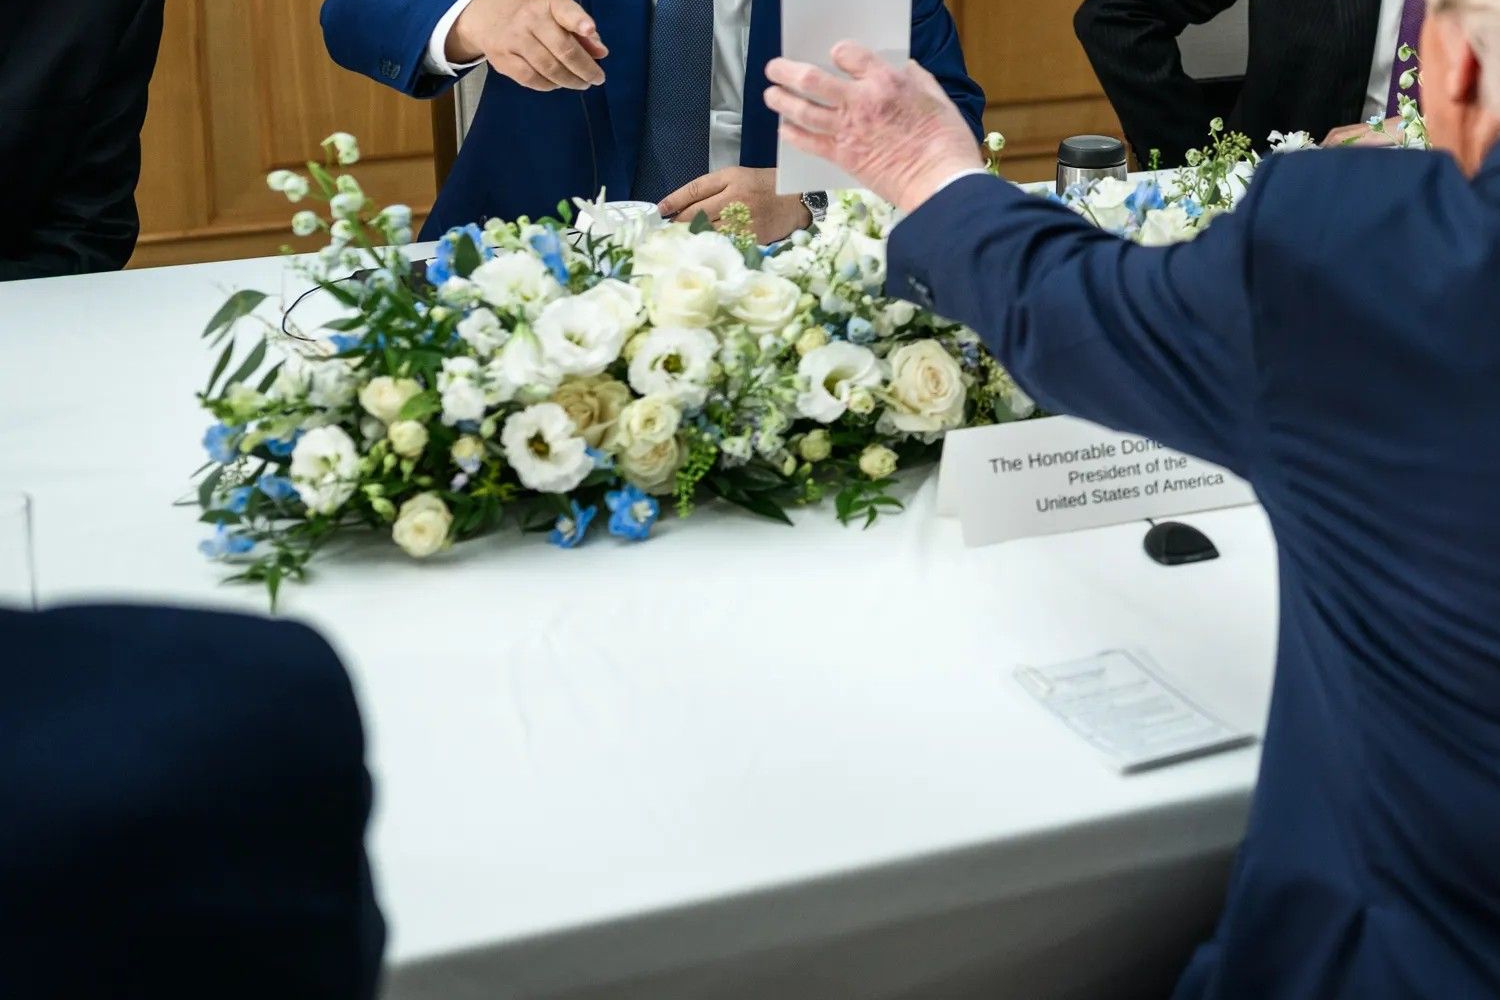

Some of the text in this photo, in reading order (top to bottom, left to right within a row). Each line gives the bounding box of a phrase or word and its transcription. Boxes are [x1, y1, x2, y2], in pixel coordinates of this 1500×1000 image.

[988, 456, 1023, 474] The
[1027, 441, 1117, 469] Honorable
[1067, 456, 1188, 485] President of the
[1035, 472, 1225, 513] United States of America
